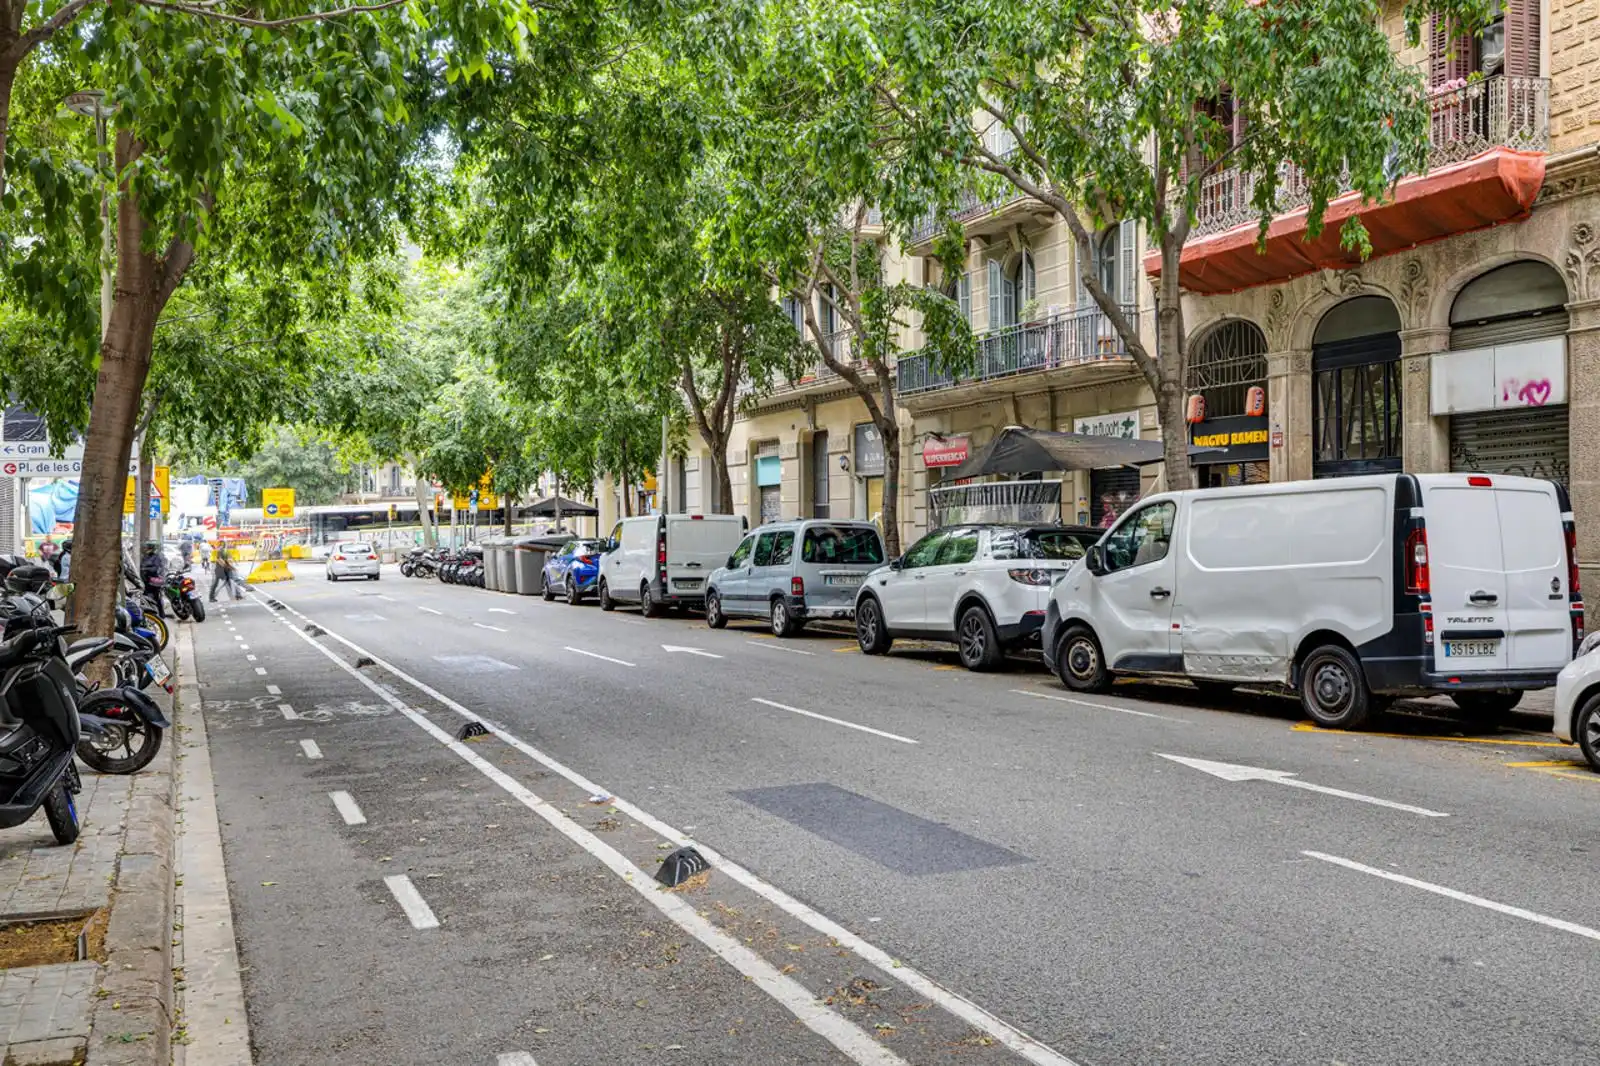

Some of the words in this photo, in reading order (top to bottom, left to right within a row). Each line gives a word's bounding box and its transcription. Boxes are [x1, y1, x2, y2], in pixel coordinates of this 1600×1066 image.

[1193, 433, 1229, 447] WAGYU
[1231, 430, 1268, 445] RAMEN
[17, 444, 45, 454] Gran
[18, 462, 33, 473] Pl.
[35, 462, 50, 473] de
[53, 462, 70, 472] les
[1446, 616, 1495, 624] TALENTO
[1451, 643, 1475, 656] 3515
[1476, 642, 1495, 655] LBZ
